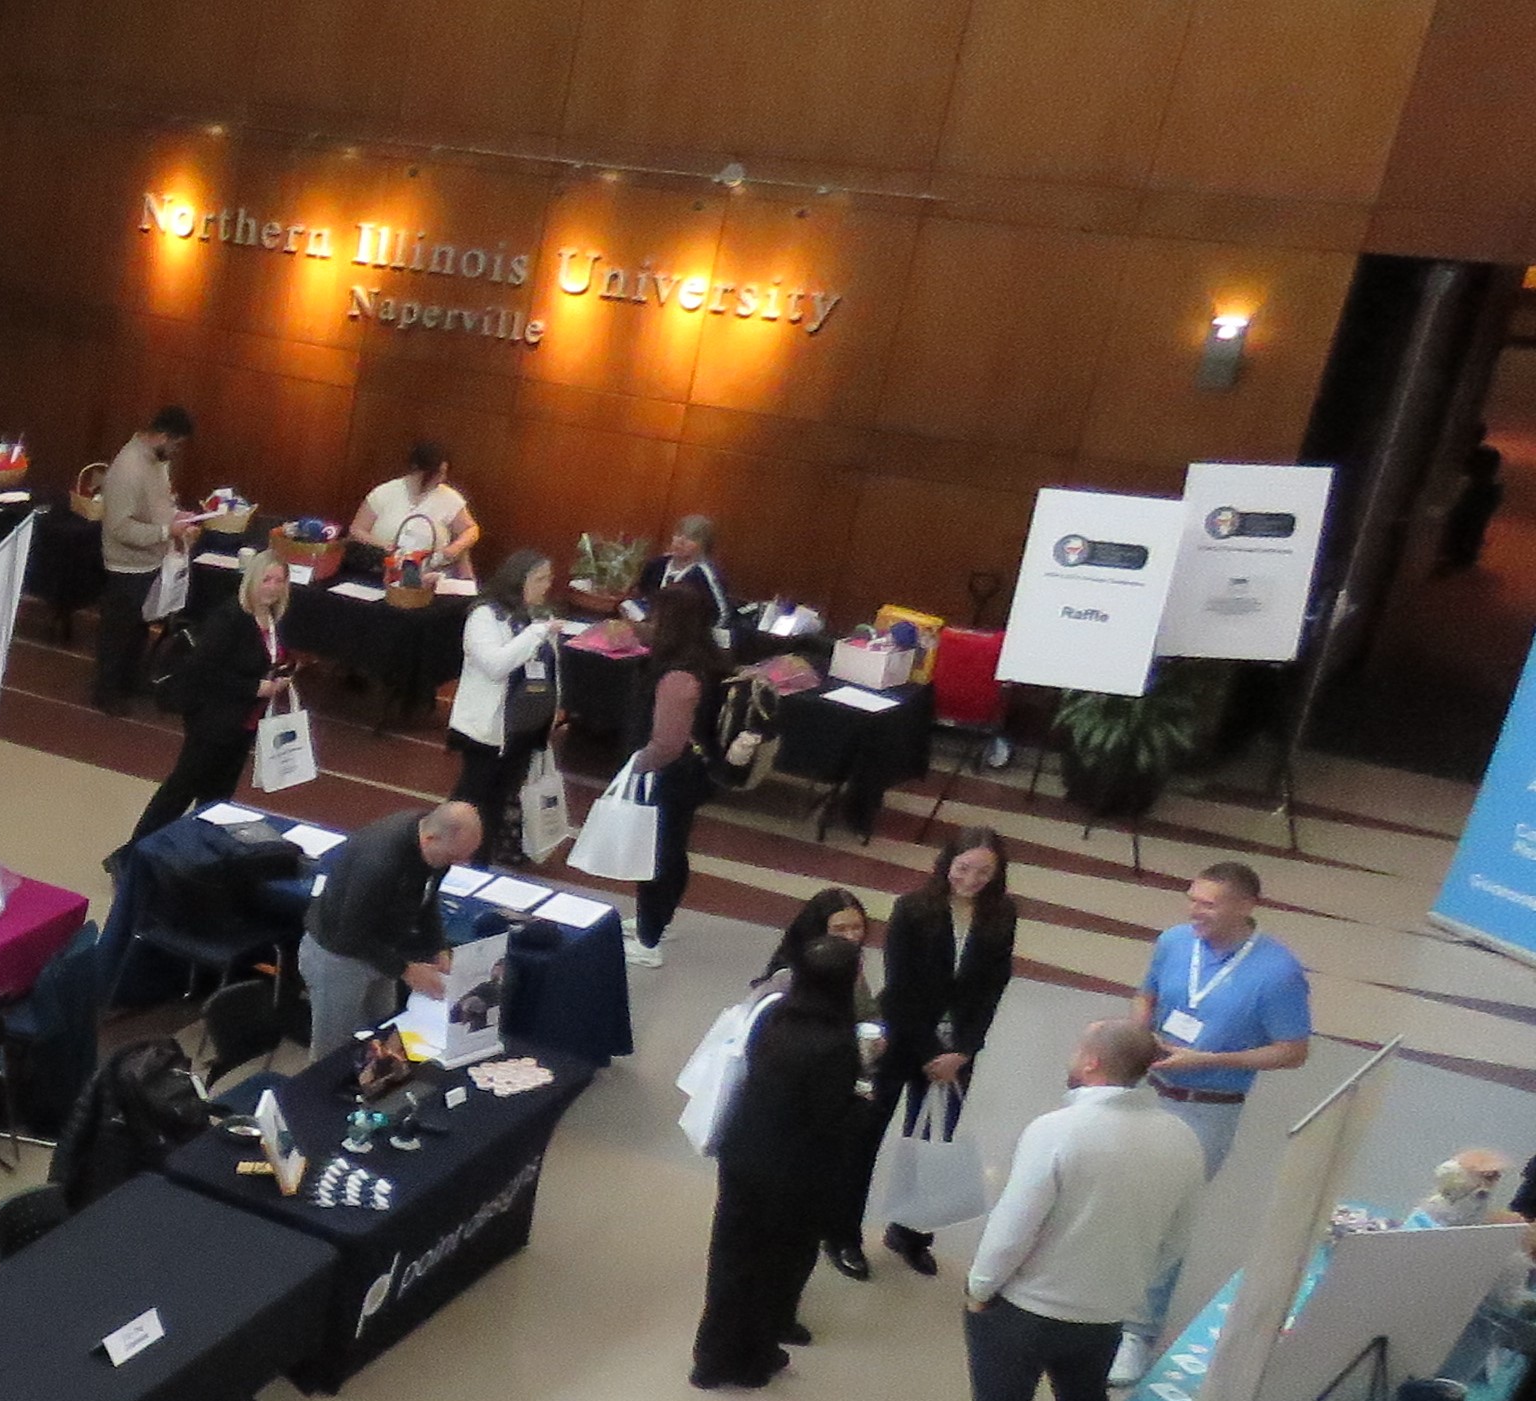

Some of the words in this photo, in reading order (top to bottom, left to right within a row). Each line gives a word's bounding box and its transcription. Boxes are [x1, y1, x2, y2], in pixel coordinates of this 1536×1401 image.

[138, 191, 333, 259] Northern
[352, 221, 530, 286] Illinois
[559, 248, 842, 333] University
[348, 284, 545, 345] Naperville
[1061, 606, 1109, 623] Raffle
